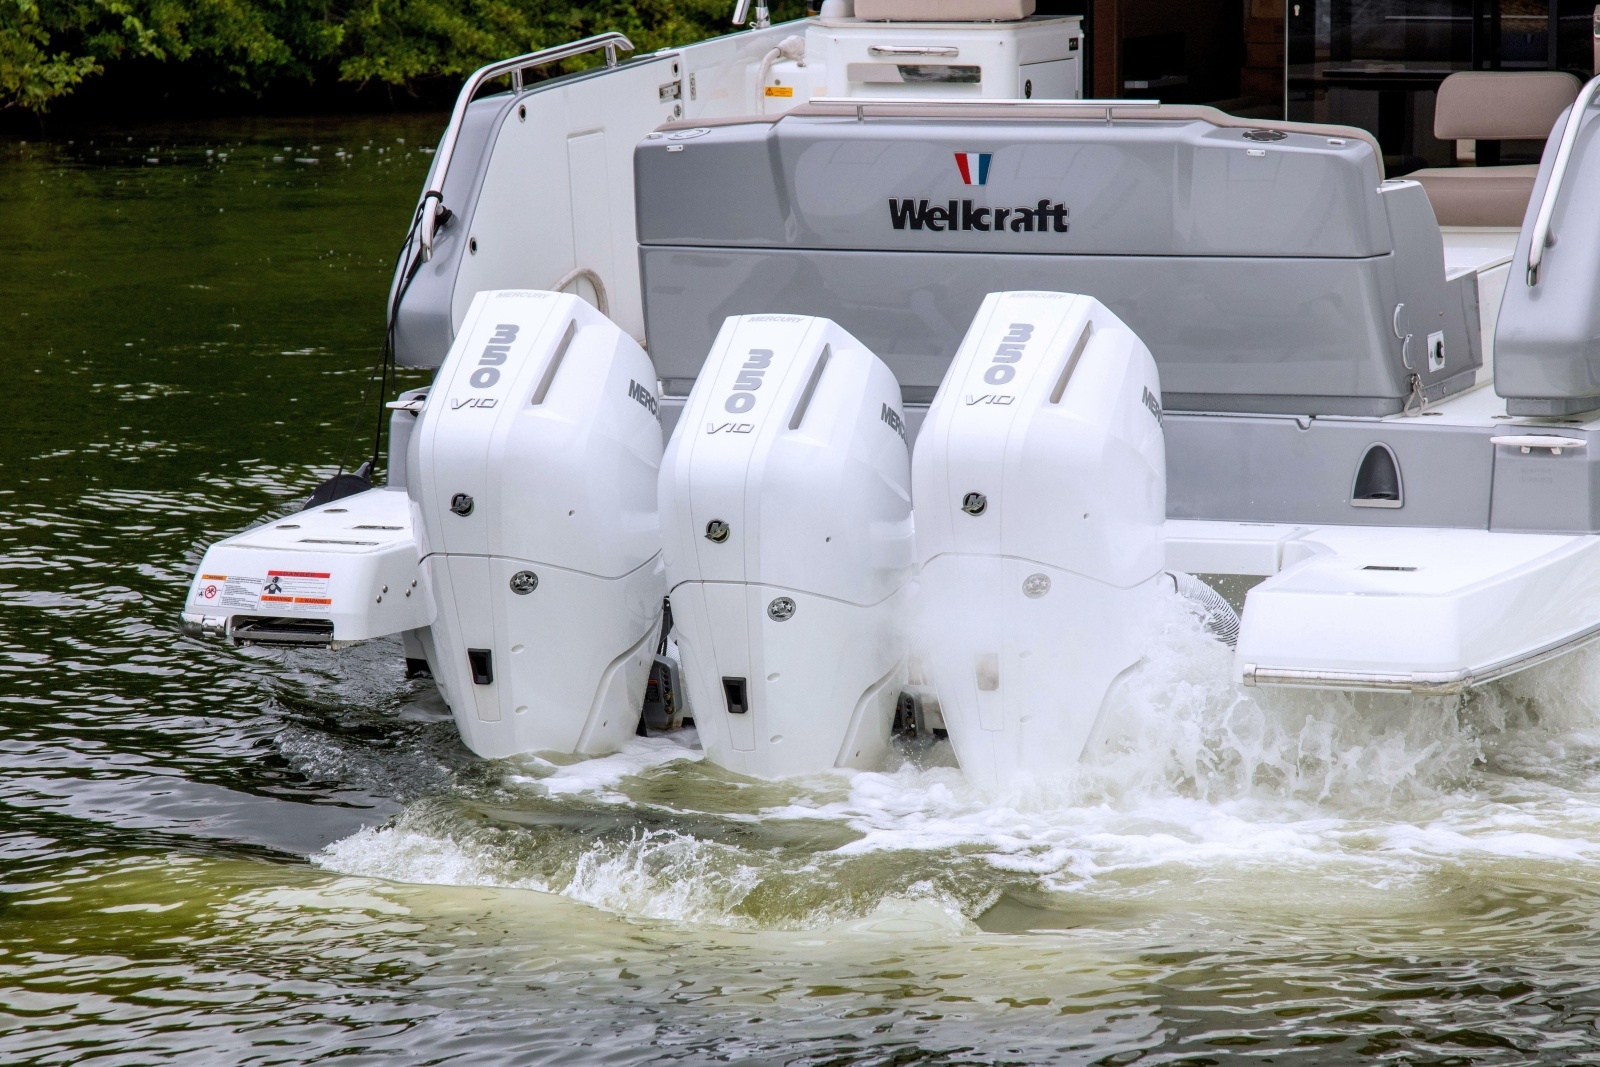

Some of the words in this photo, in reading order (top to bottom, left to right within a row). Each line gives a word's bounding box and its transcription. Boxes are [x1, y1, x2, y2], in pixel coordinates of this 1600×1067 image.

[888, 197, 1069, 233] Wellcraft
[496, 291, 551, 299] MERCURY
[469, 323, 520, 389] 350
[983, 323, 1035, 386] 350
[724, 348, 774, 414] 350
[451, 398, 499, 410] V10
[966, 394, 1016, 406] V10
[706, 422, 755, 435] V10
